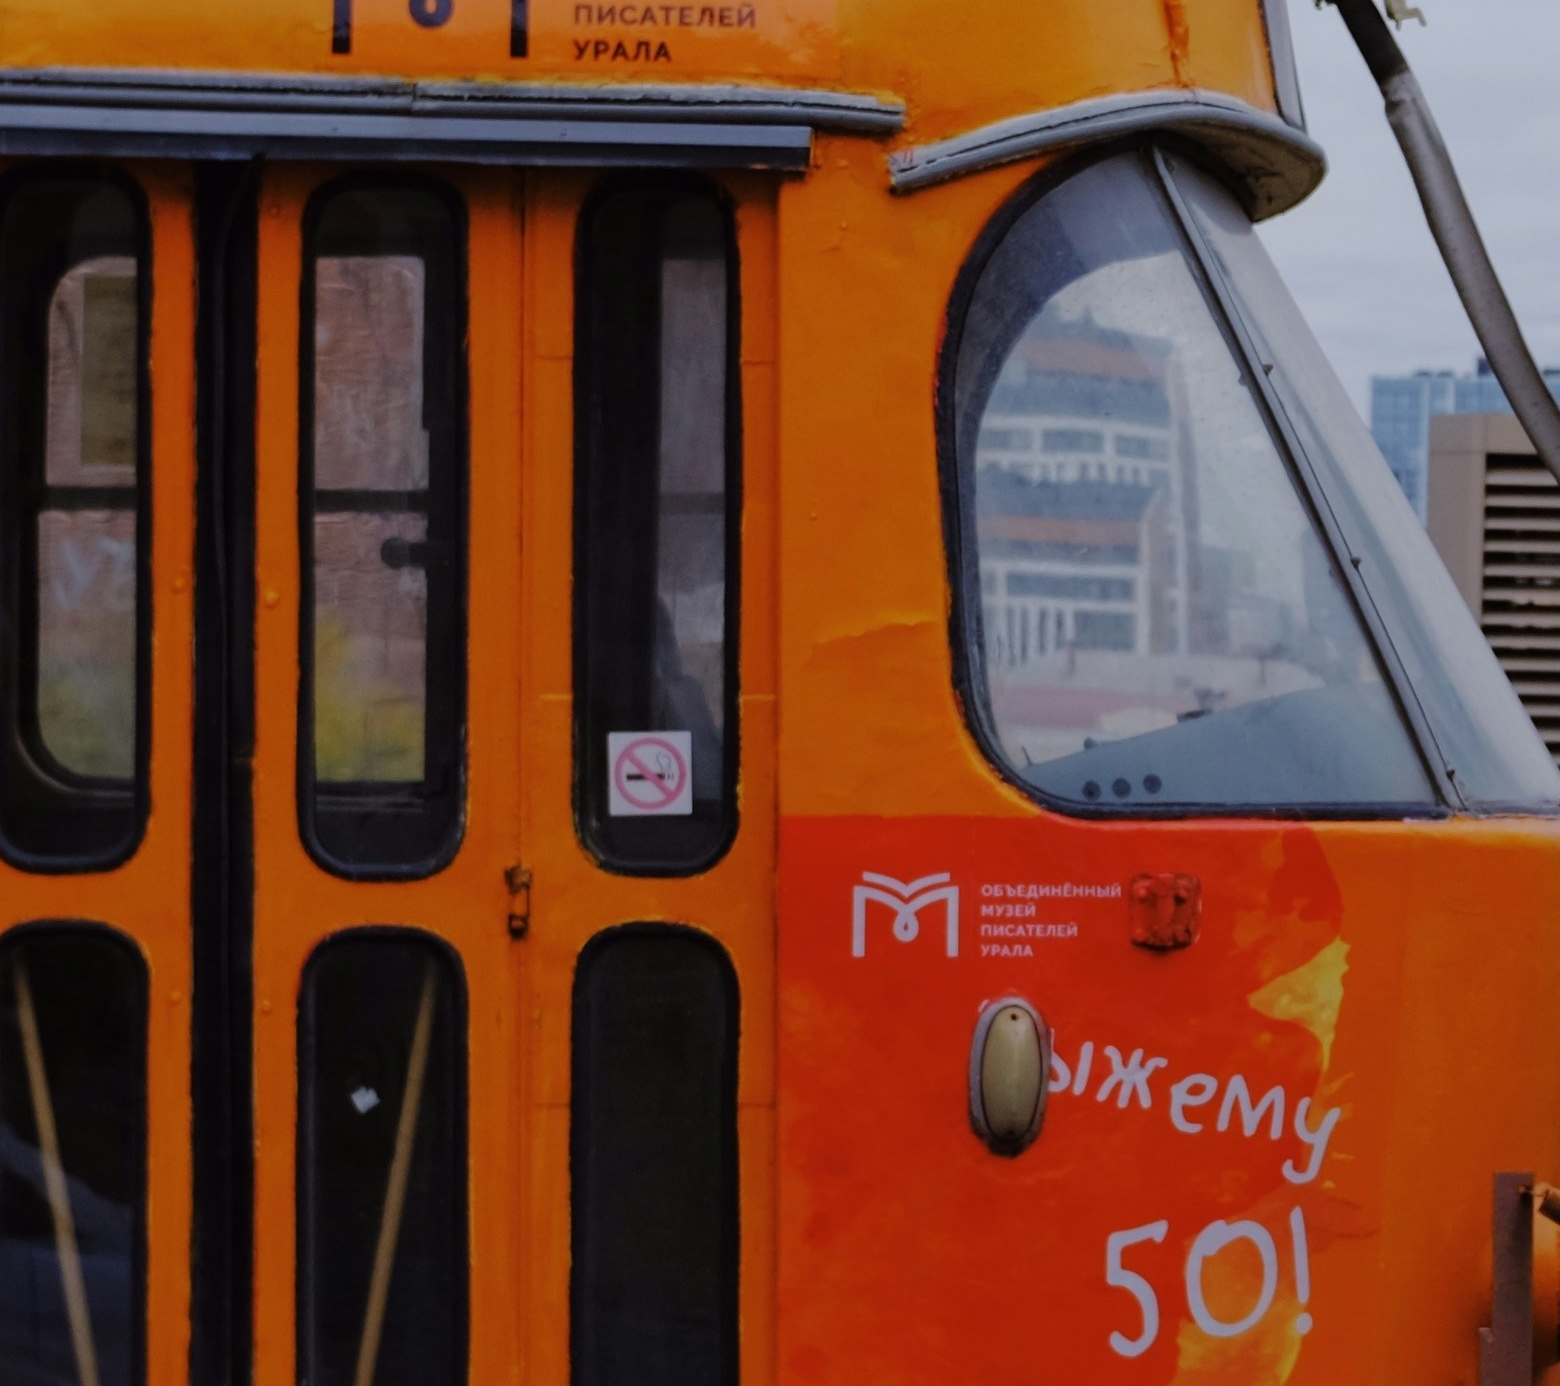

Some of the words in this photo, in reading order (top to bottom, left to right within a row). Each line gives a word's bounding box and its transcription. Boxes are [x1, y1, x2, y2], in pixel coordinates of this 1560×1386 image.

[574, 2, 757, 28] ПИСАТЕЛЕЙ
[573, 39, 672, 62] УРАЛА
[981, 883, 1121, 899] ОБЪЕДИНЁННЫЙ
[981, 902, 1036, 917] МУЗЕЙ
[981, 922, 1078, 937] ПИСАТЕЛЕЙ
[980, 944, 1034, 957] УРАЛА
[1048, 1029, 1340, 1183] ыжему
[1104, 1205, 1313, 1358] 50!
